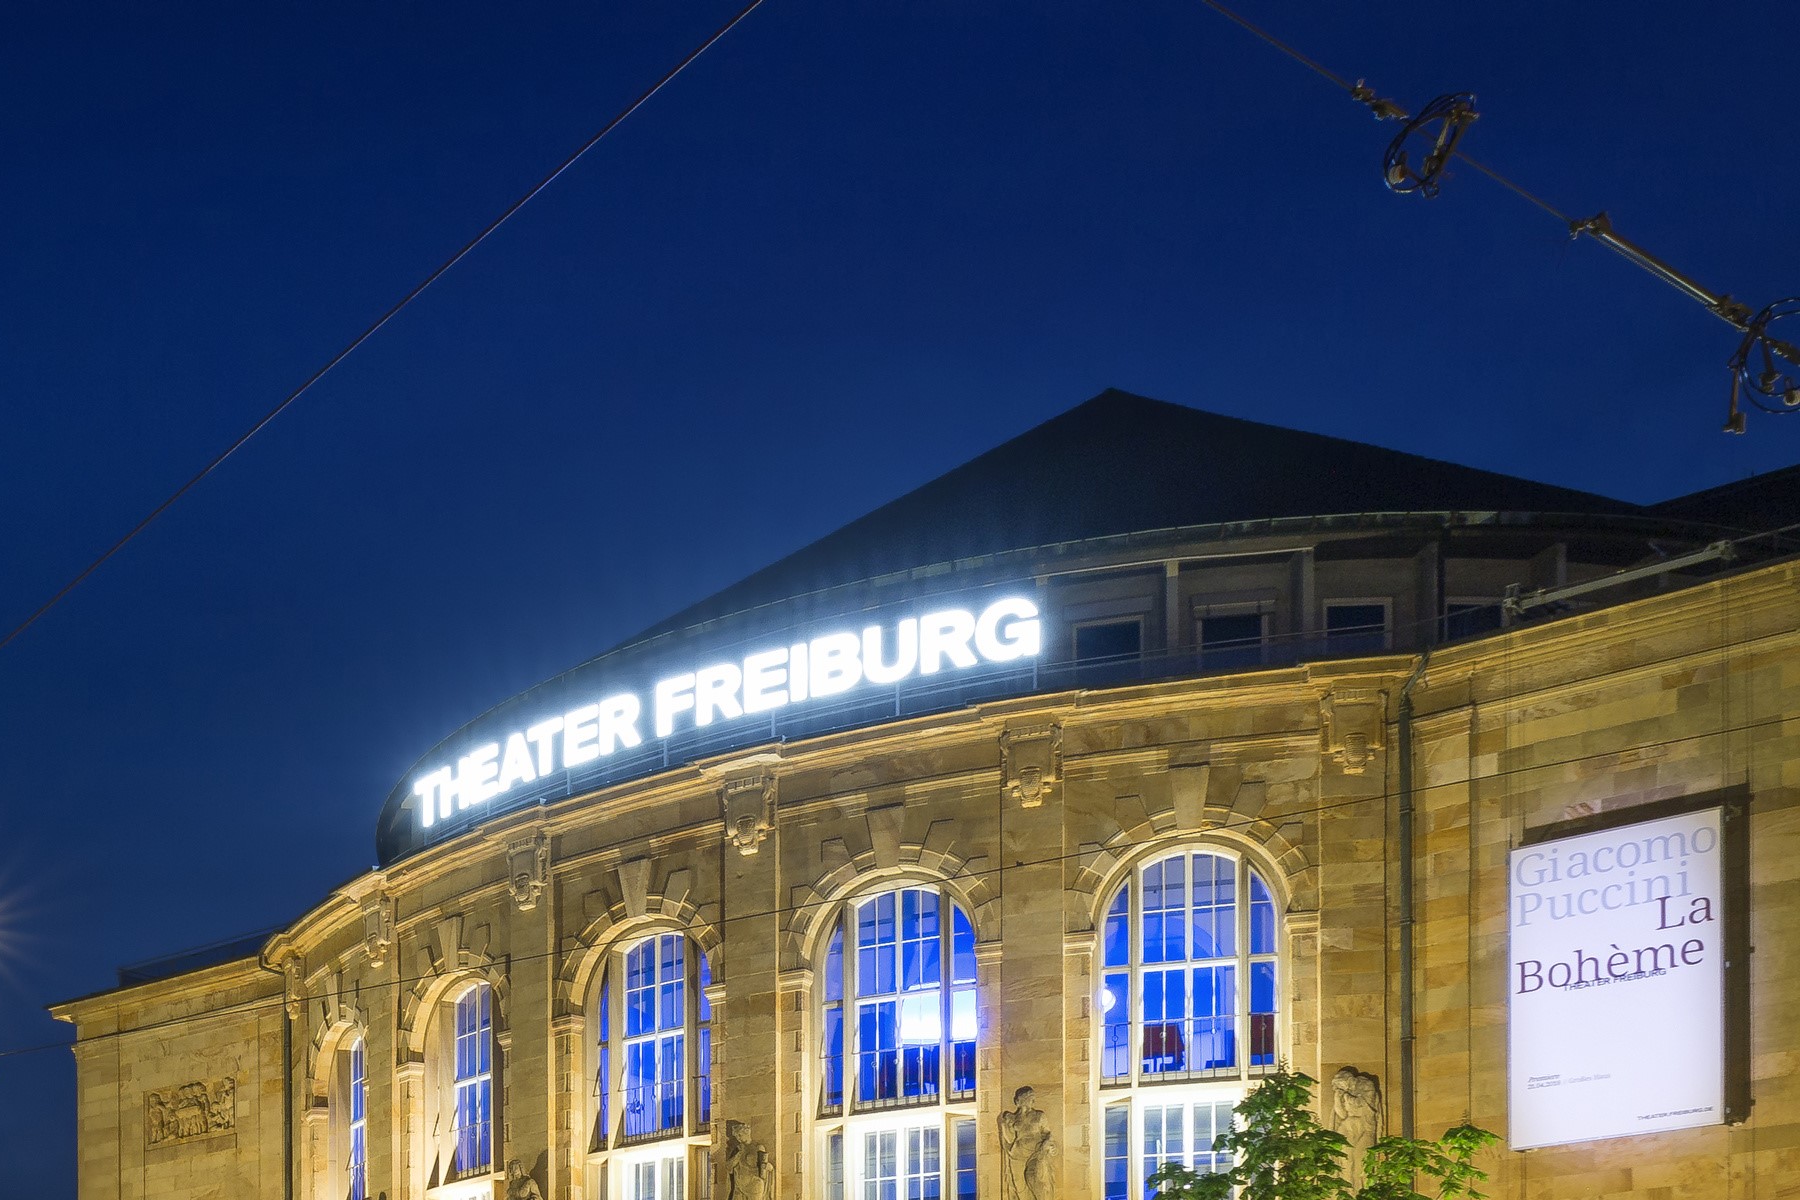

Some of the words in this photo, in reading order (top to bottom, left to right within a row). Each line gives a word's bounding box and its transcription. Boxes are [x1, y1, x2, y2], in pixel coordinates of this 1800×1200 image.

[414, 694, 641, 828] THEATER
[655, 598, 1040, 738] FREIBURG
[1516, 827, 1716, 887] Giacomo
[1516, 861, 1692, 927] Puccini
[1656, 895, 1715, 930] La
[1516, 937, 1705, 994] Bohème
[1564, 977, 1611, 991] THEATER
[1613, 968, 1667, 984] FREIBURG
